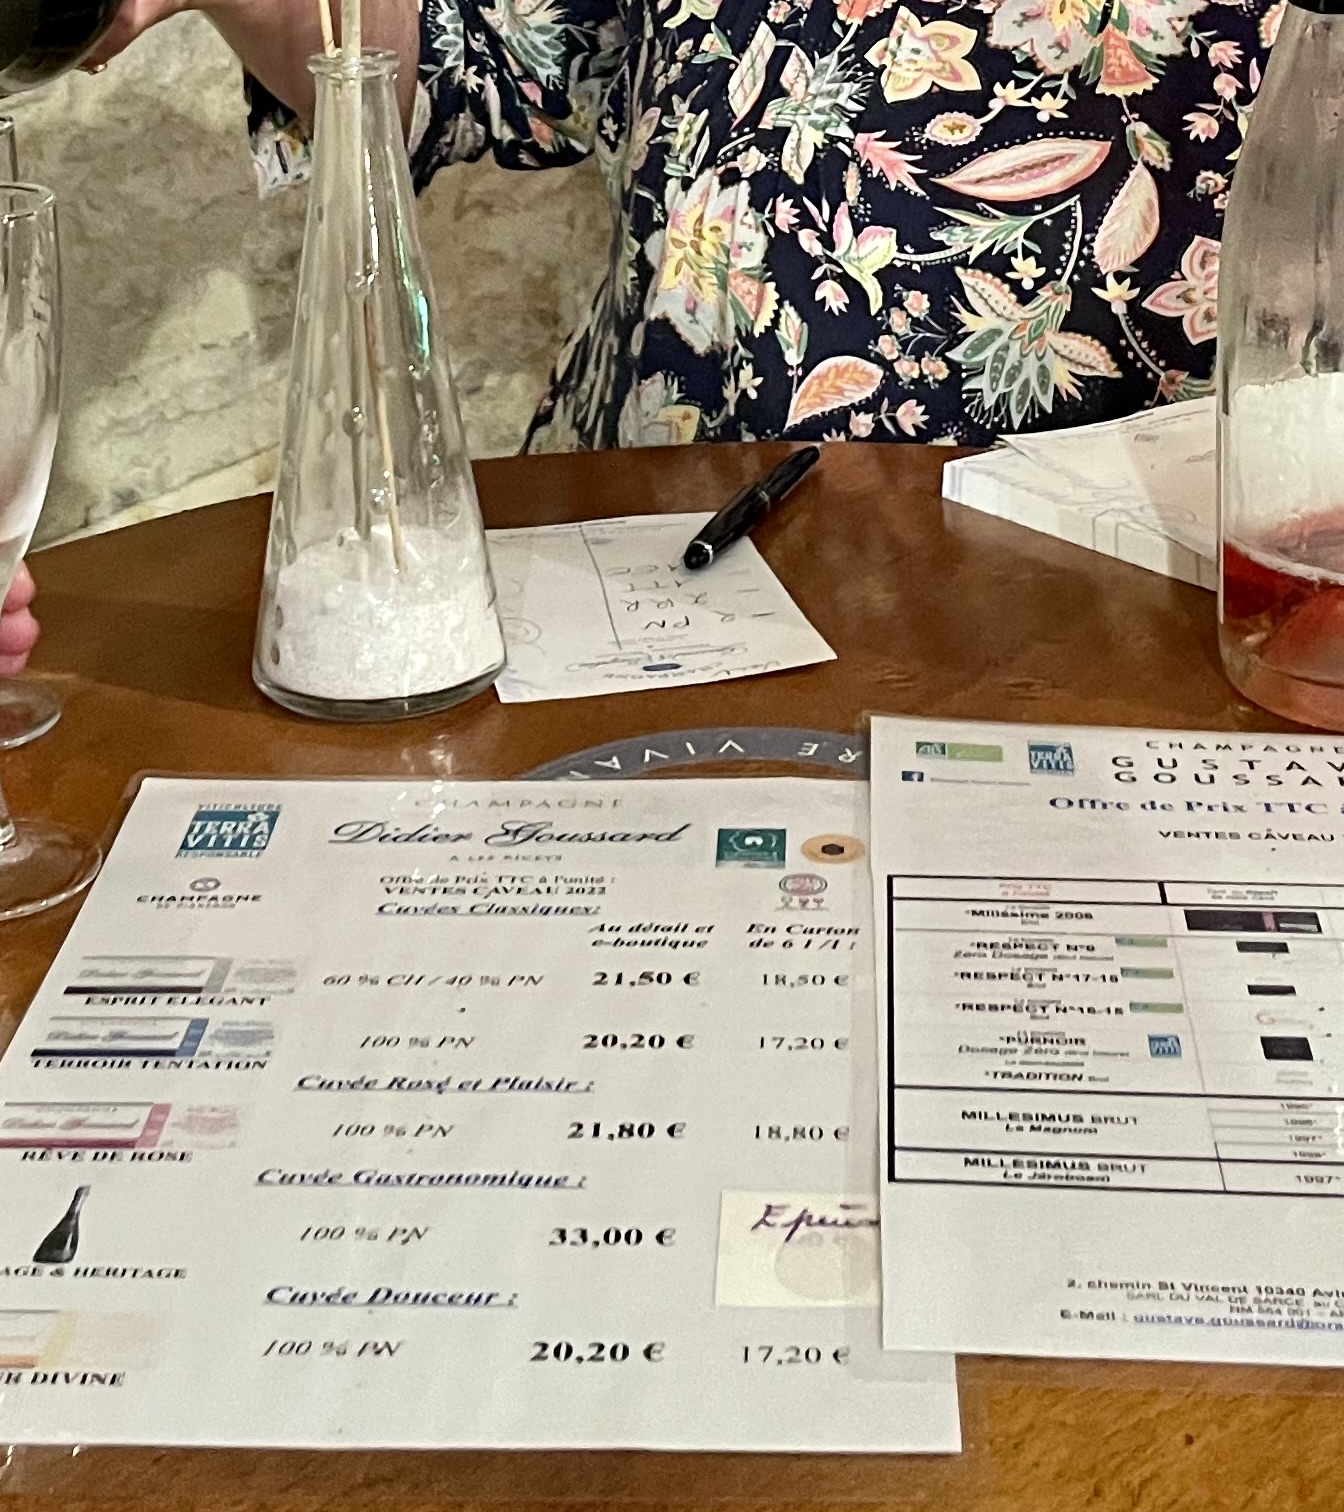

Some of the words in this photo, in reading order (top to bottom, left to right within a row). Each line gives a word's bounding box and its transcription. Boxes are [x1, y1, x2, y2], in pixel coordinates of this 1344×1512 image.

[413, 798, 623, 809] CHAMPAGNE
[1050, 796, 1130, 811] Offre
[1141, 800, 1174, 812] de
[1185, 800, 1248, 813] Prix
[1256, 801, 1329, 815] TTC
[191, 820, 270, 835] TERRA
[328, 819, 474, 845] Didier
[484, 819, 693, 848] Goussard
[1158, 830, 1241, 840] VENTES
[187, 834, 268, 849] VITIS
[455, 872, 488, 885] Prix
[496, 875, 533, 885] TTC
[136, 893, 263, 904] CHAMPAGNE
[384, 886, 467, 896] VENTES
[376, 901, 458, 916] Cuvées
[588, 923, 620, 934] Au
[628, 921, 688, 934] détail
[695, 923, 716, 934] et
[745, 923, 777, 934] En
[786, 923, 860, 935] Carton
[592, 936, 709, 949] e-boutique
[748, 937, 775, 948] de
[782, 938, 794, 948] 6
[508, 974, 545, 988] PN
[592, 971, 673, 987] 21,50
[683, 971, 702, 986] €
[761, 973, 826, 988] 18,50
[358, 1035, 401, 1049] 100
[436, 1036, 476, 1049] PN
[582, 1033, 666, 1051] 20,20
[676, 1034, 696, 1049] €
[759, 1036, 826, 1051] 17,20
[141, 1058, 269, 1070] TENTATION
[296, 1074, 379, 1091] Cuvée
[387, 1074, 452, 1092] Rosé
[457, 1076, 483, 1090] et
[489, 1074, 576, 1090] Plaisir
[332, 1122, 376, 1138] 100
[413, 1124, 454, 1138] PN
[567, 1122, 656, 1141] 21,80
[666, 1122, 687, 1138] €
[754, 1125, 824, 1142] 18,80
[92, 1150, 125, 1162] DE
[256, 1168, 344, 1187] Cuvée
[353, 1168, 569, 1189] Gastronomique
[300, 1226, 346, 1242] 100
[386, 1226, 430, 1245] PN
[548, 1227, 644, 1249] 33,00
[655, 1228, 677, 1247] €
[265, 1286, 359, 1306] Cuvée
[366, 1286, 500, 1306] Douceur
[262, 1339, 312, 1357] 100
[357, 1340, 402, 1358] PN
[529, 1341, 631, 1364] 20,20
[642, 1342, 667, 1362] €
[742, 1345, 822, 1365] 17,20
[31, 1371, 127, 1387] DIVINE
